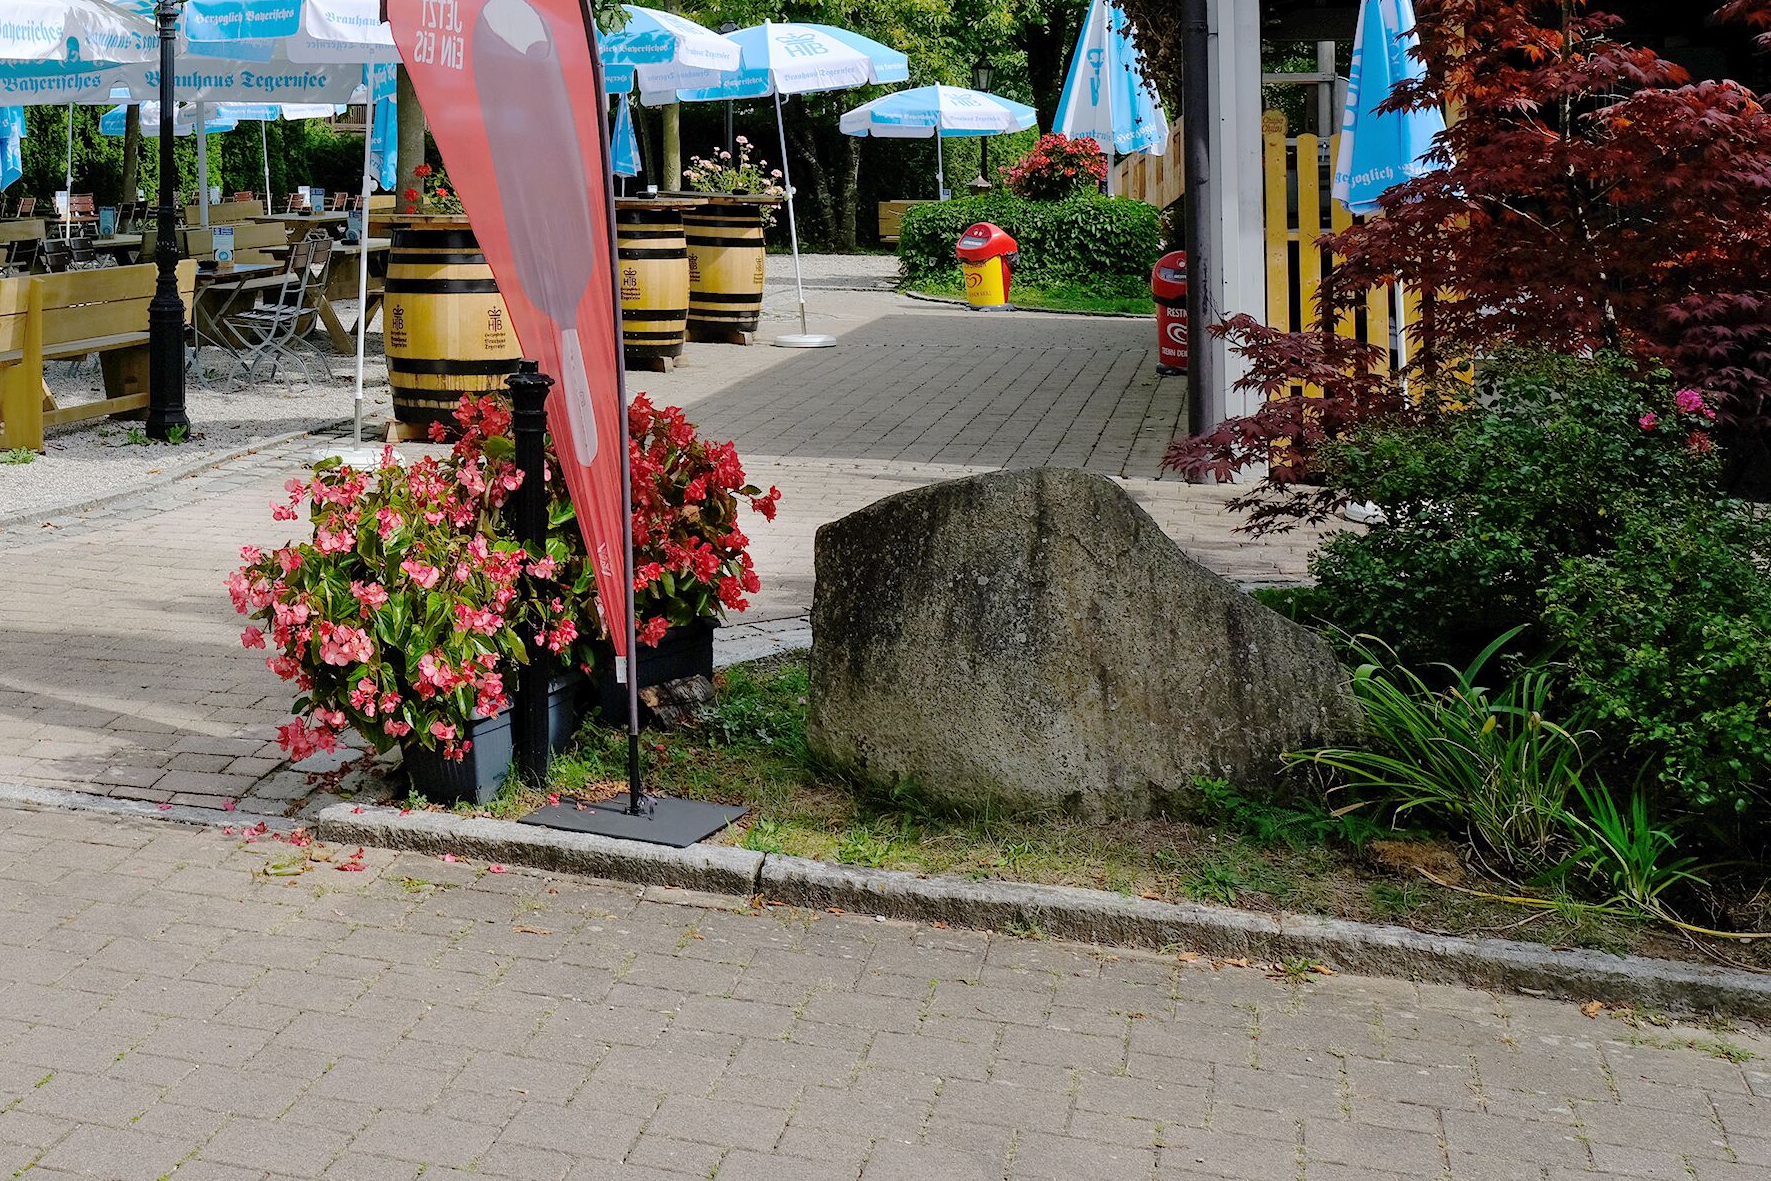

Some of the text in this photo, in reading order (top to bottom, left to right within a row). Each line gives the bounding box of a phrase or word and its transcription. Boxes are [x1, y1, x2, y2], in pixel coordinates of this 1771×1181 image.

[195, 12, 243, 27] Herzoglich
[783, 41, 830, 58] HTB
[488, 317, 503, 332] HTB
